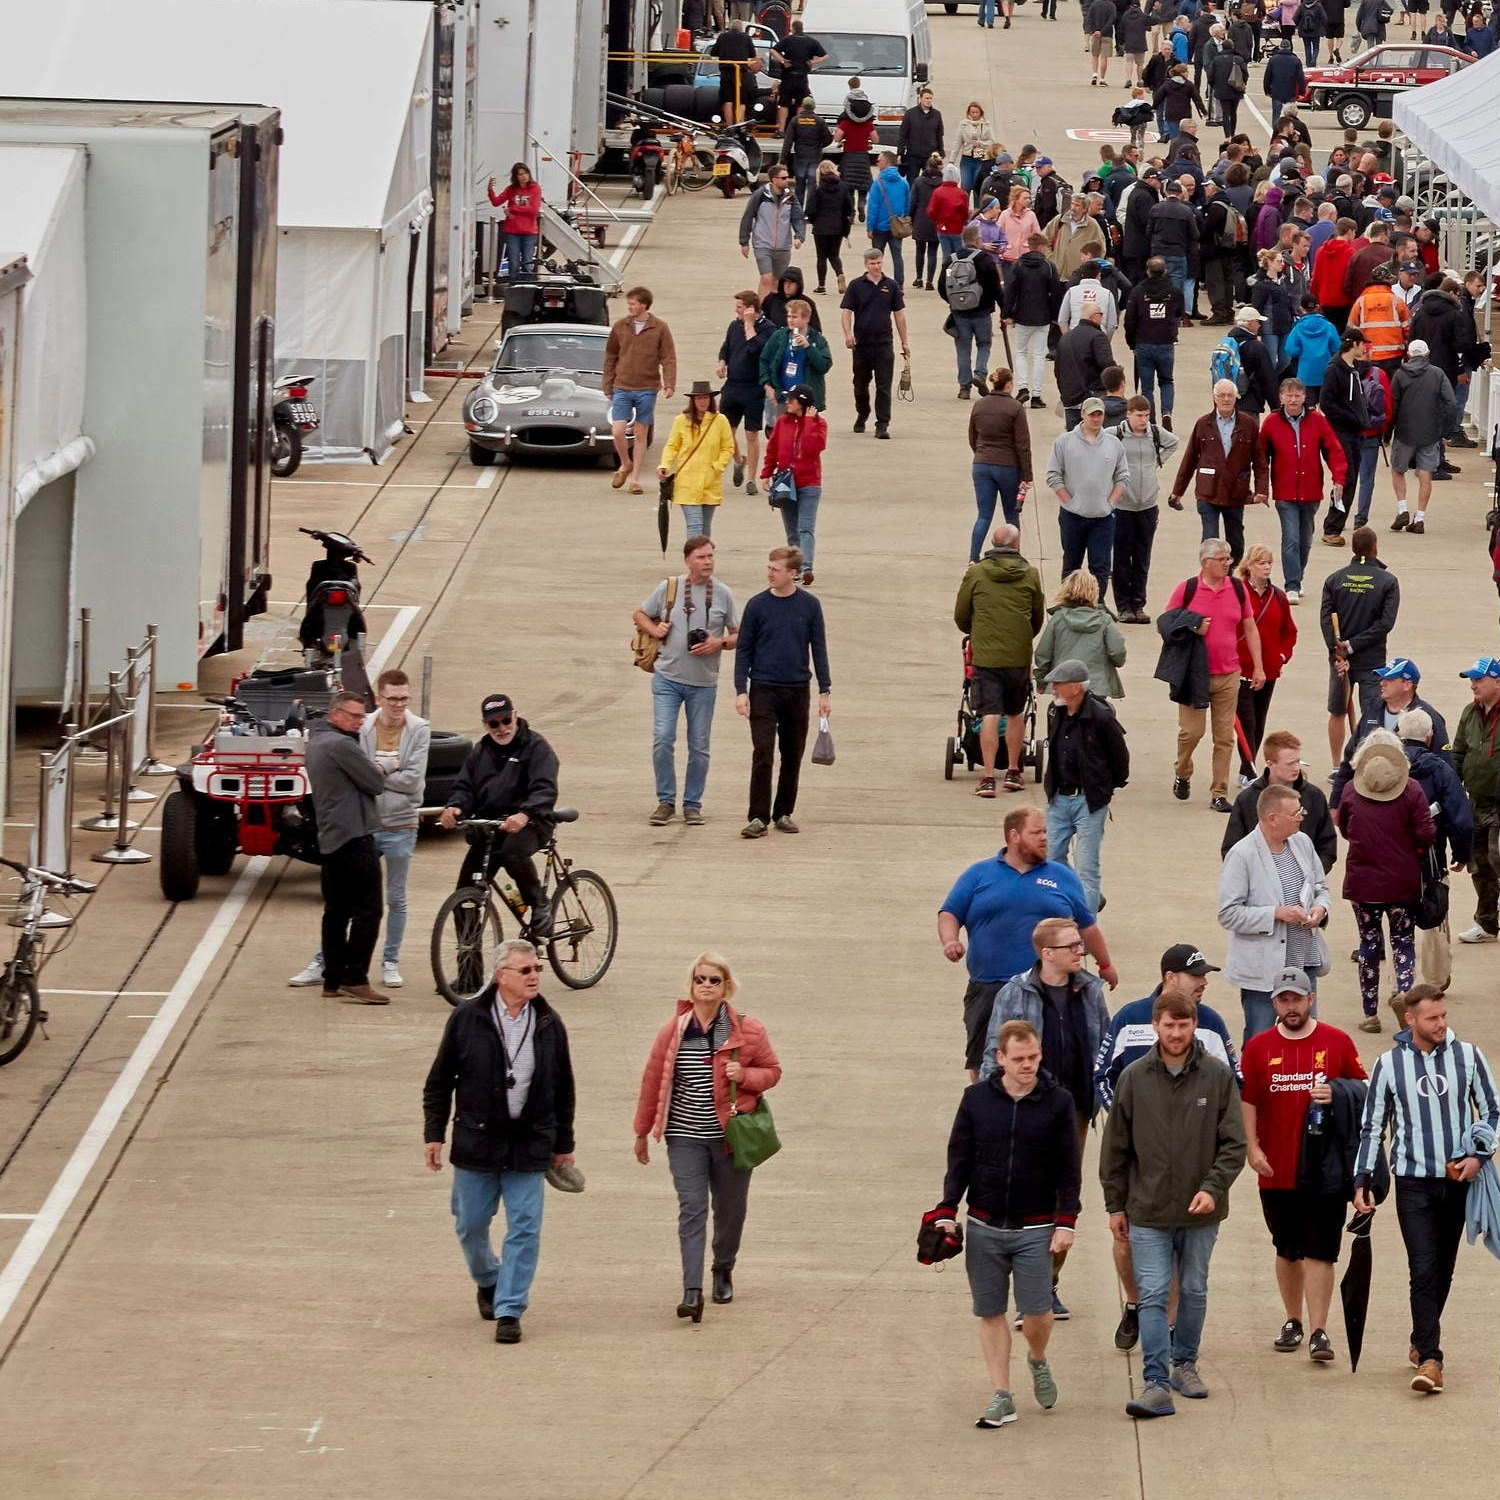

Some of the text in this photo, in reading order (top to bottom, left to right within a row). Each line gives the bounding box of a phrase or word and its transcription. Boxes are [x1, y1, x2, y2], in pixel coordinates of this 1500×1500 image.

[528, 409, 575, 417] 898 CVN
[1271, 1071, 1314, 1084] Standard
[1269, 1080, 1314, 1093] Chartered
